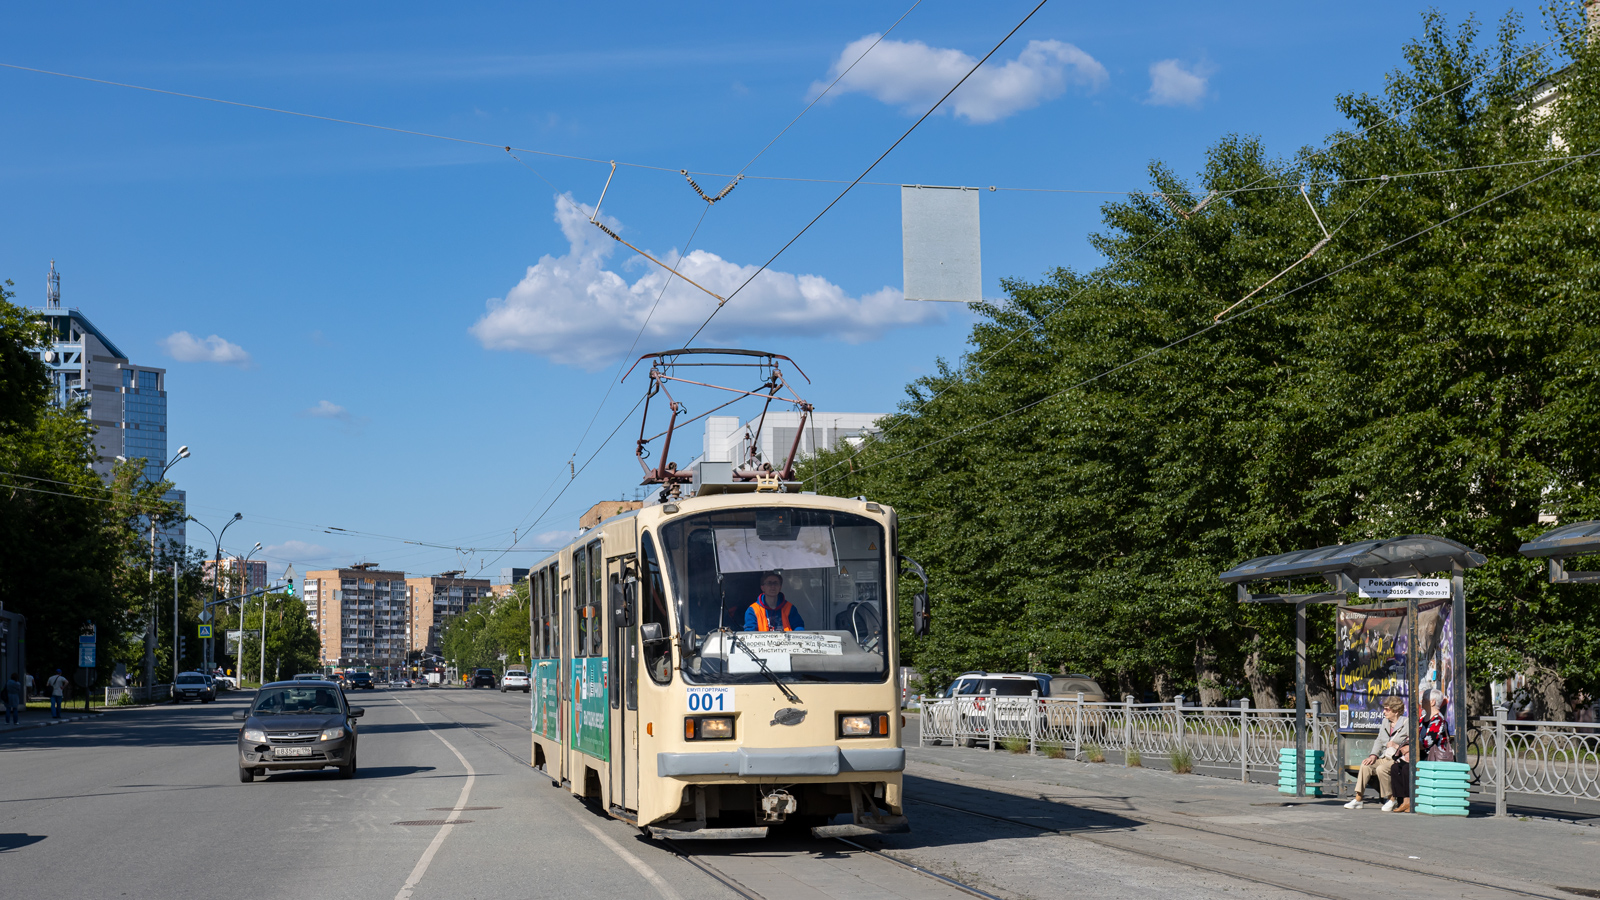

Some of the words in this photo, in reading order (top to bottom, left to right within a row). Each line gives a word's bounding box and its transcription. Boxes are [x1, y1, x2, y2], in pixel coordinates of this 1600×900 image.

[1368, 580, 1412, 588] Рекламное
[688, 692, 724, 711] 001
[1354, 711, 1358, 719] 8
